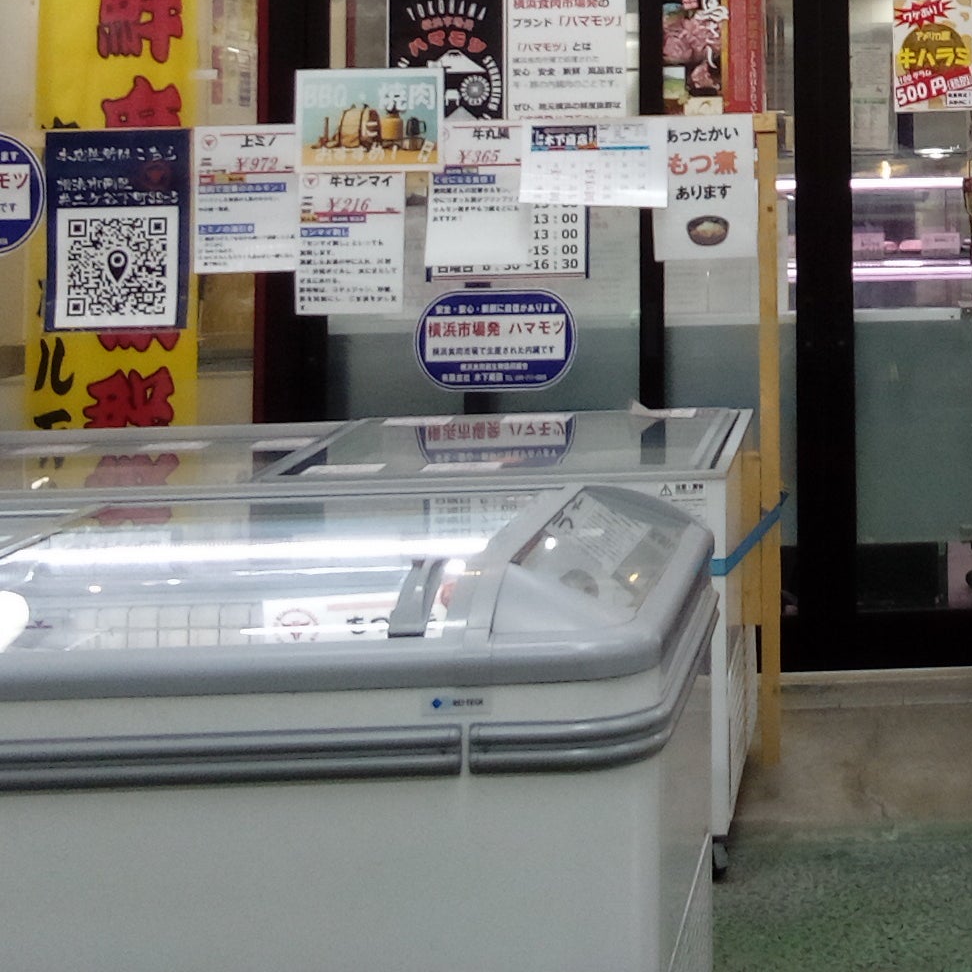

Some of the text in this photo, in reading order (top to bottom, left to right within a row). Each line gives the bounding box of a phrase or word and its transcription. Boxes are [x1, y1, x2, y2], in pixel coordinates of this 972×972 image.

[668, 150, 738, 176] もつ煮
[676, 183, 732, 200] あります
[428, 319, 565, 339] 横浜市場発 ハマモツ
